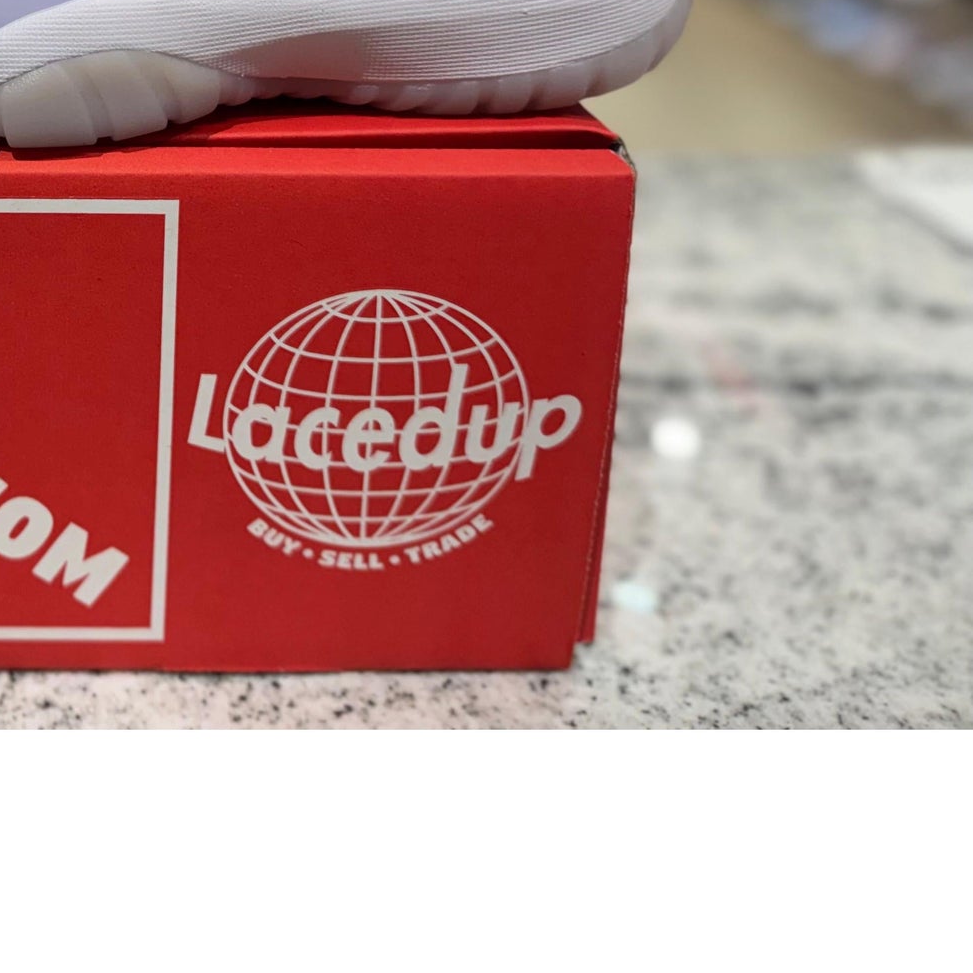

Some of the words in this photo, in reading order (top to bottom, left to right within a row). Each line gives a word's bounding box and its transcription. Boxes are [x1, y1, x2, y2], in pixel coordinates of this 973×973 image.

[187, 364, 582, 480] Lacedup
[247, 518, 302, 556] BUY
[318, 550, 384, 570] SELL
[404, 514, 493, 564] TRADE
